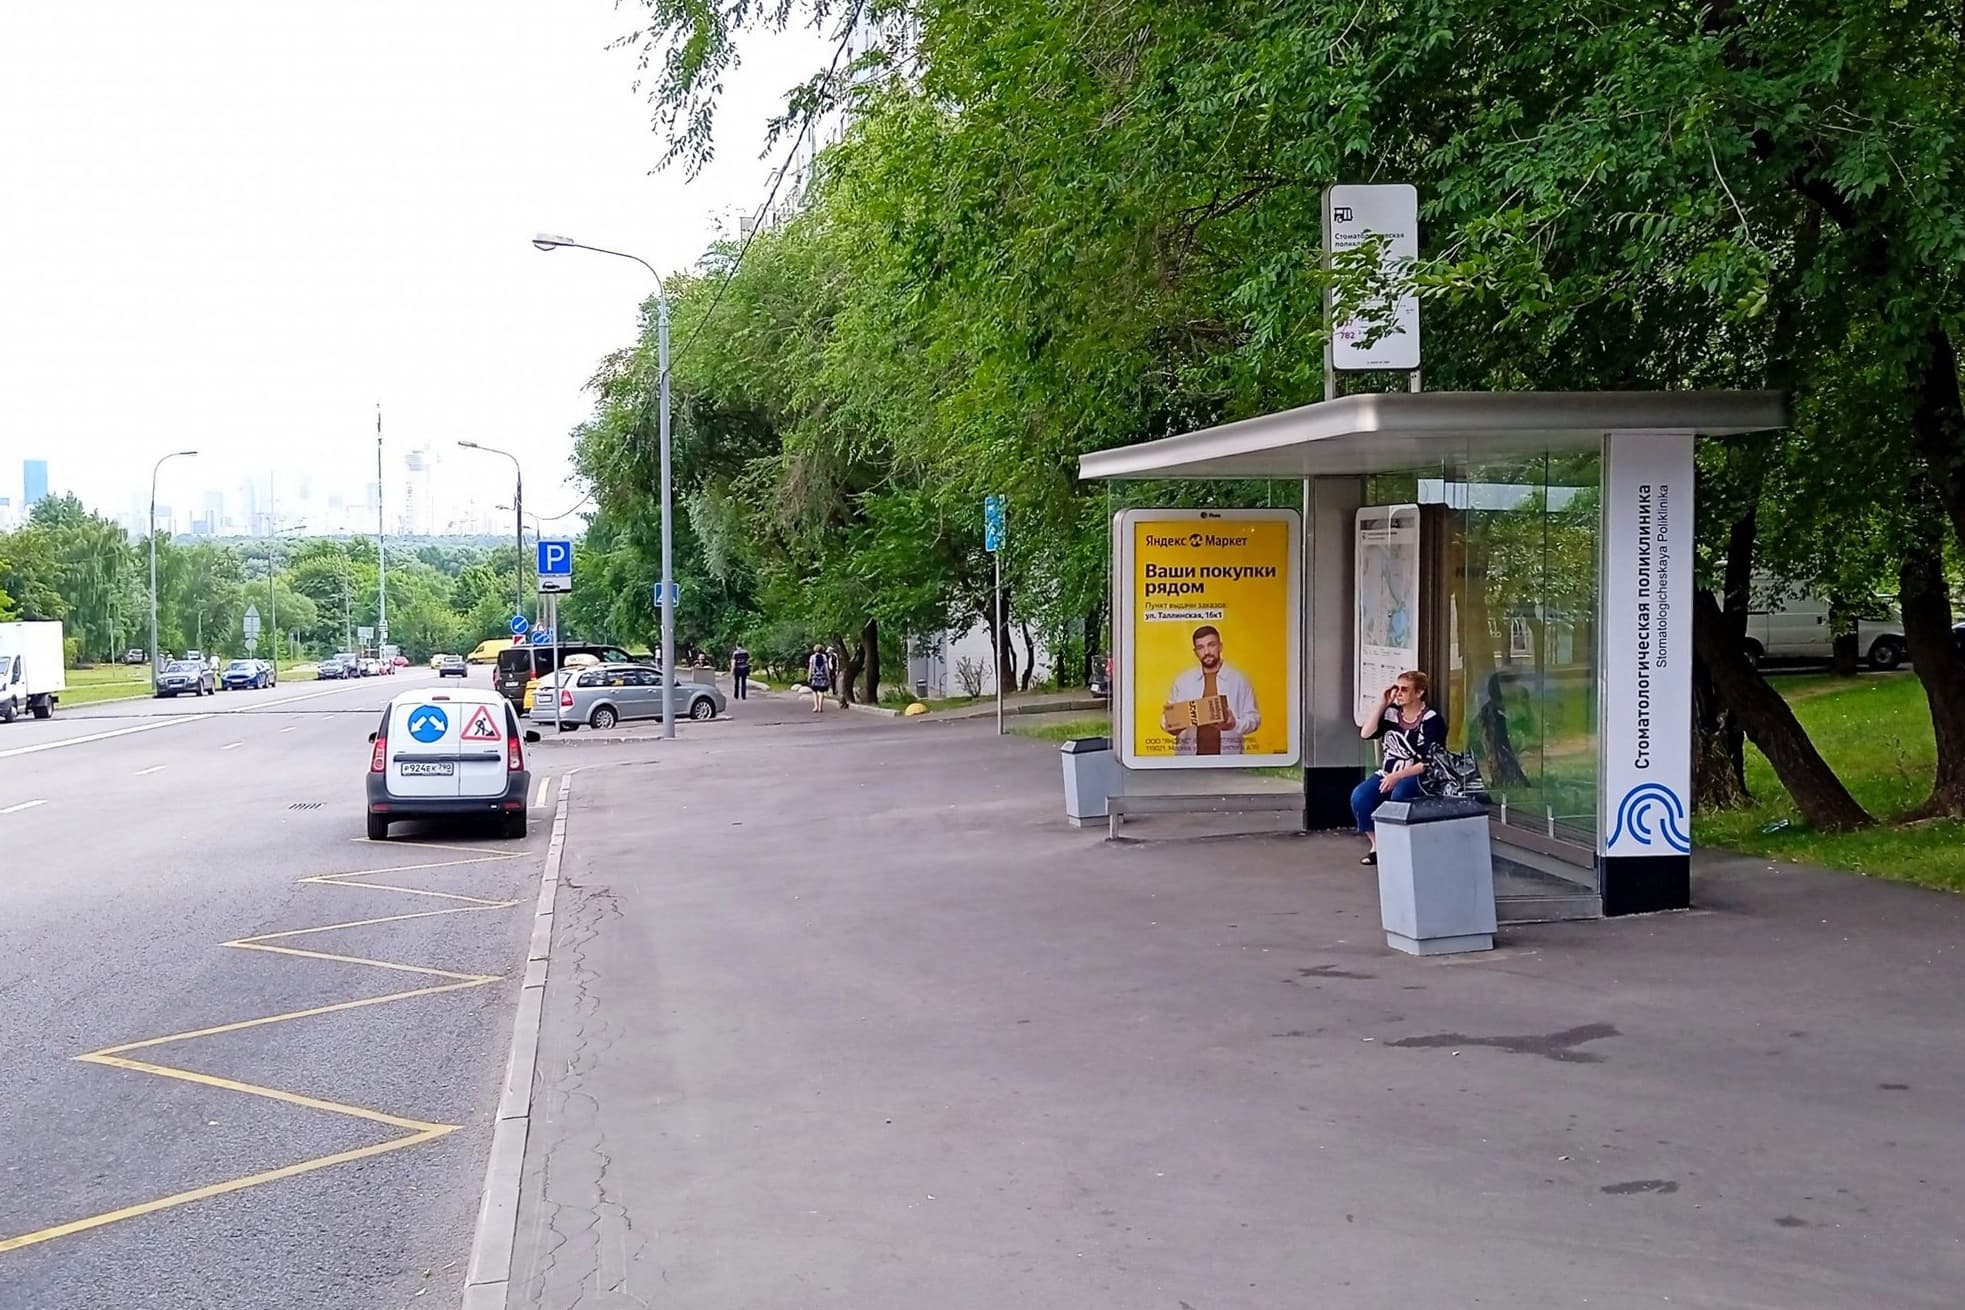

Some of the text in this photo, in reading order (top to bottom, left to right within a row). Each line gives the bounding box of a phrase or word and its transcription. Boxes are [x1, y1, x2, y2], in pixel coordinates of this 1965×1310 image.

[1340, 331, 1355, 339] 782
[1145, 534, 1248, 548] Яндекс Маркет
[547, 545, 565, 571] P
[1145, 563, 1276, 582] Ваши покупки
[1655, 484, 1670, 669] Stomatologicheskaya Poliklinika
[1145, 582, 1205, 597] рядом
[1145, 601, 1168, 610] Пункт
[1145, 612, 1157, 620] ул.
[1158, 611, 1204, 620] Таллинская,
[1634, 484, 1651, 770] Стоматологическая поликлиника
